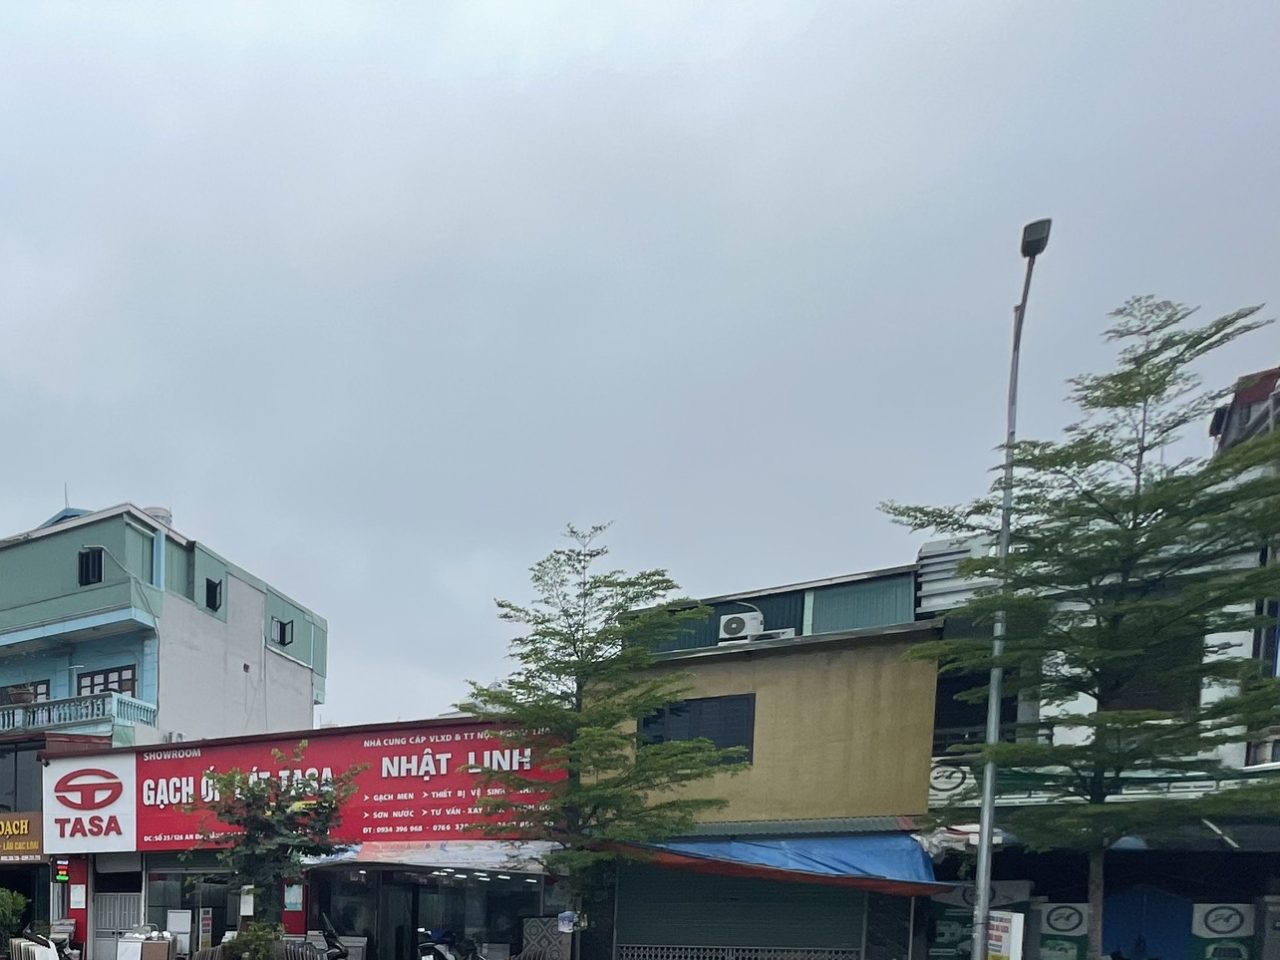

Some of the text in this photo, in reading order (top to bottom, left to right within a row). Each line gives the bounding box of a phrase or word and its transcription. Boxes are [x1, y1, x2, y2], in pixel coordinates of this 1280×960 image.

[383, 737, 407, 746] CUNG
[429, 734, 452, 743] VLXD
[464, 732, 475, 740] TT
[477, 729, 494, 741] NỘ
[143, 748, 201, 761] SHOWROOM
[382, 747, 531, 781] NHẬT LINH
[143, 776, 195, 809] GẠCH
[373, 792, 414, 802] GẠCH MEN
[54, 815, 123, 839] TASA
